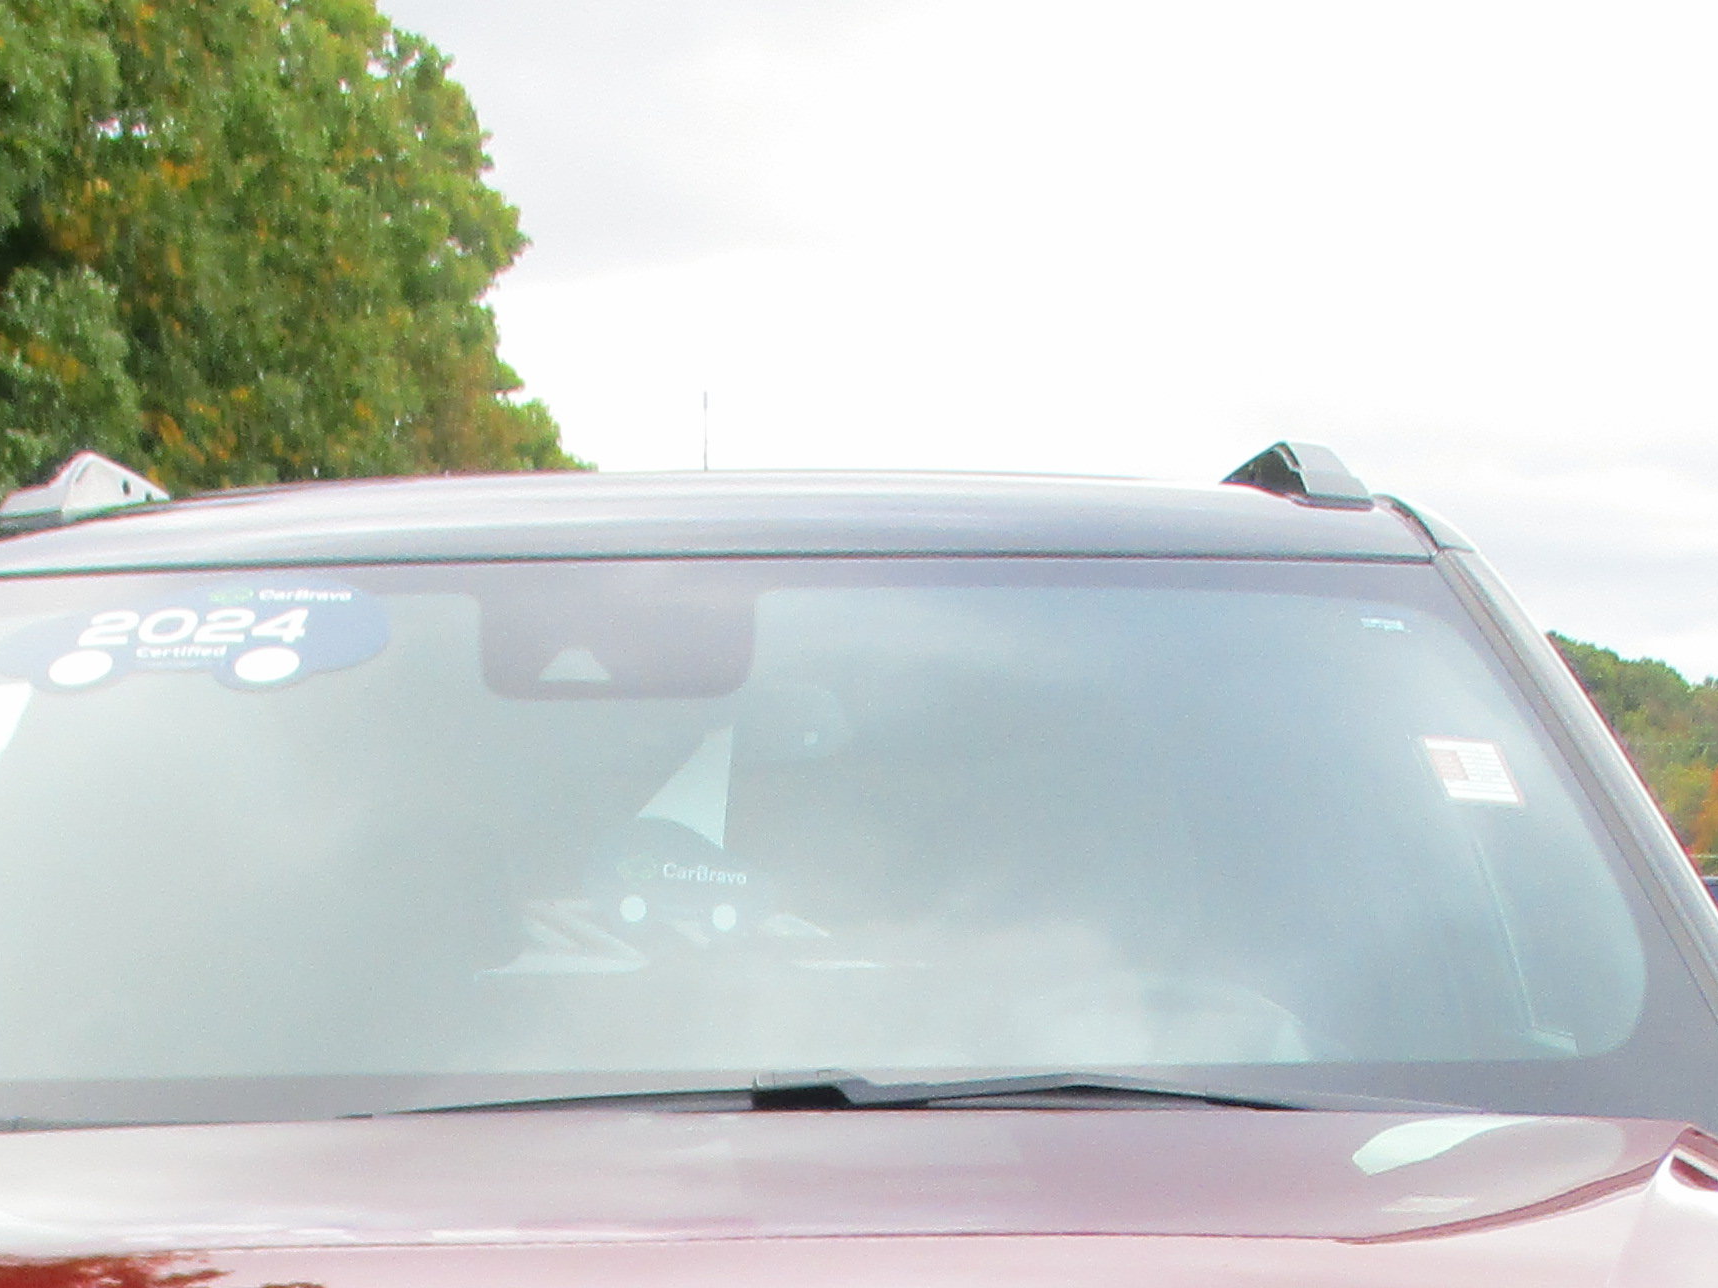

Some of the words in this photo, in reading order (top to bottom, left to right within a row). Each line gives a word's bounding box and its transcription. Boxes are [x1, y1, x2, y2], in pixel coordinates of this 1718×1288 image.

[78, 608, 309, 645] 2024
[135, 644, 228, 659] Certified
[663, 862, 747, 884] CarBravo
